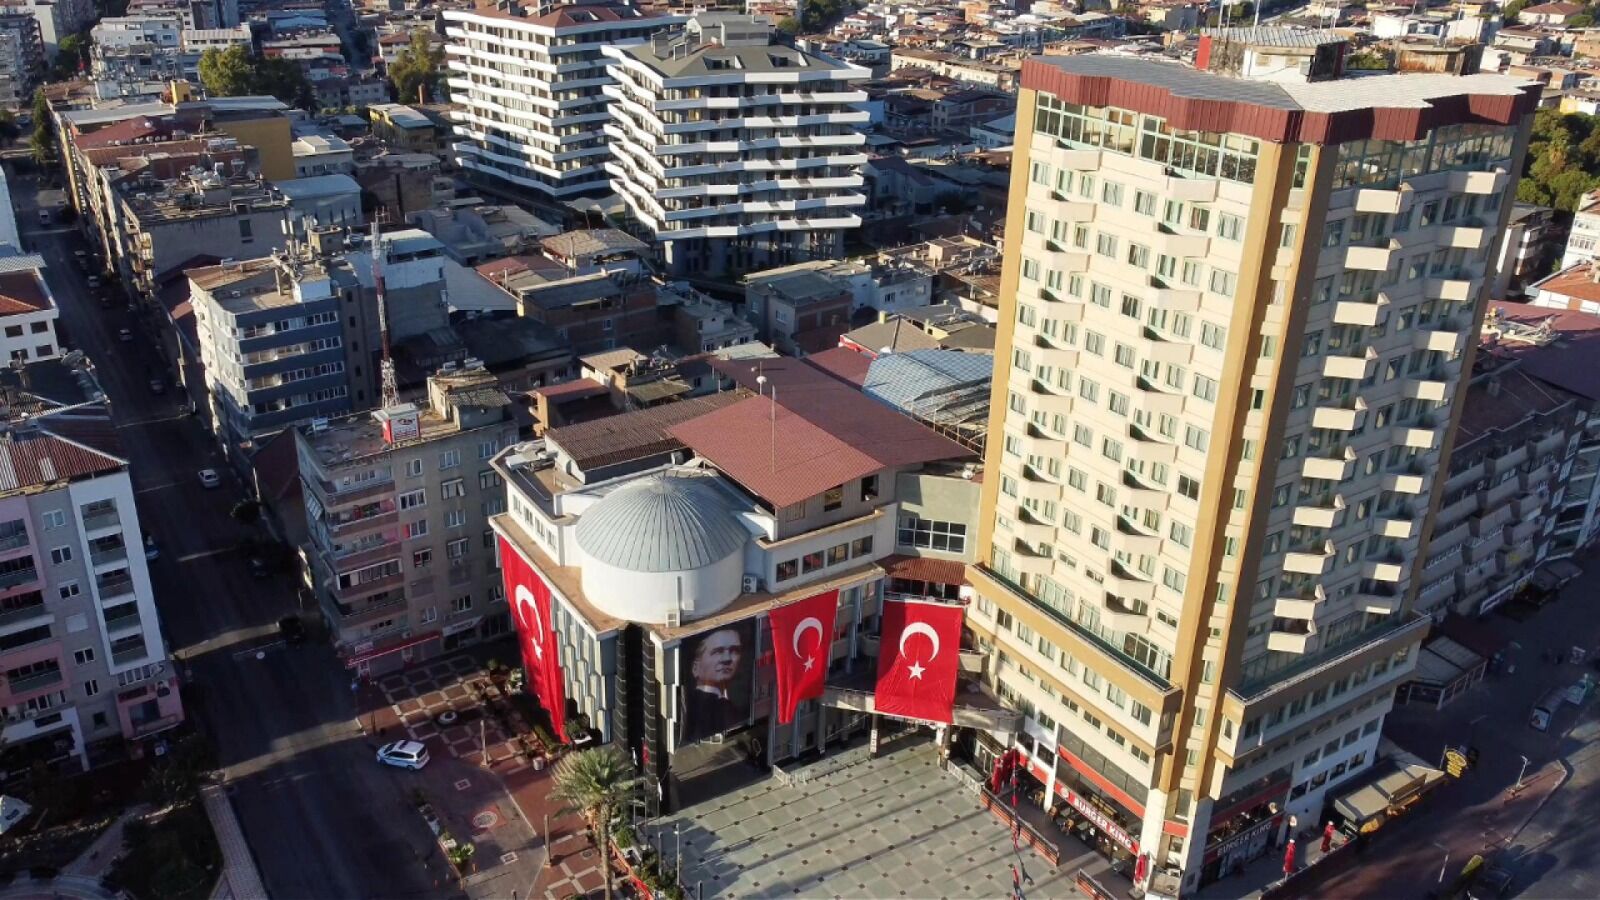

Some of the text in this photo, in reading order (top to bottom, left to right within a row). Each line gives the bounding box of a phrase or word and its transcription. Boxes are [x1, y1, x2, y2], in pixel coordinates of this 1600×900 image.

[1074, 797, 1132, 848] BURGER KING
[1217, 820, 1272, 857] BURGER KING
